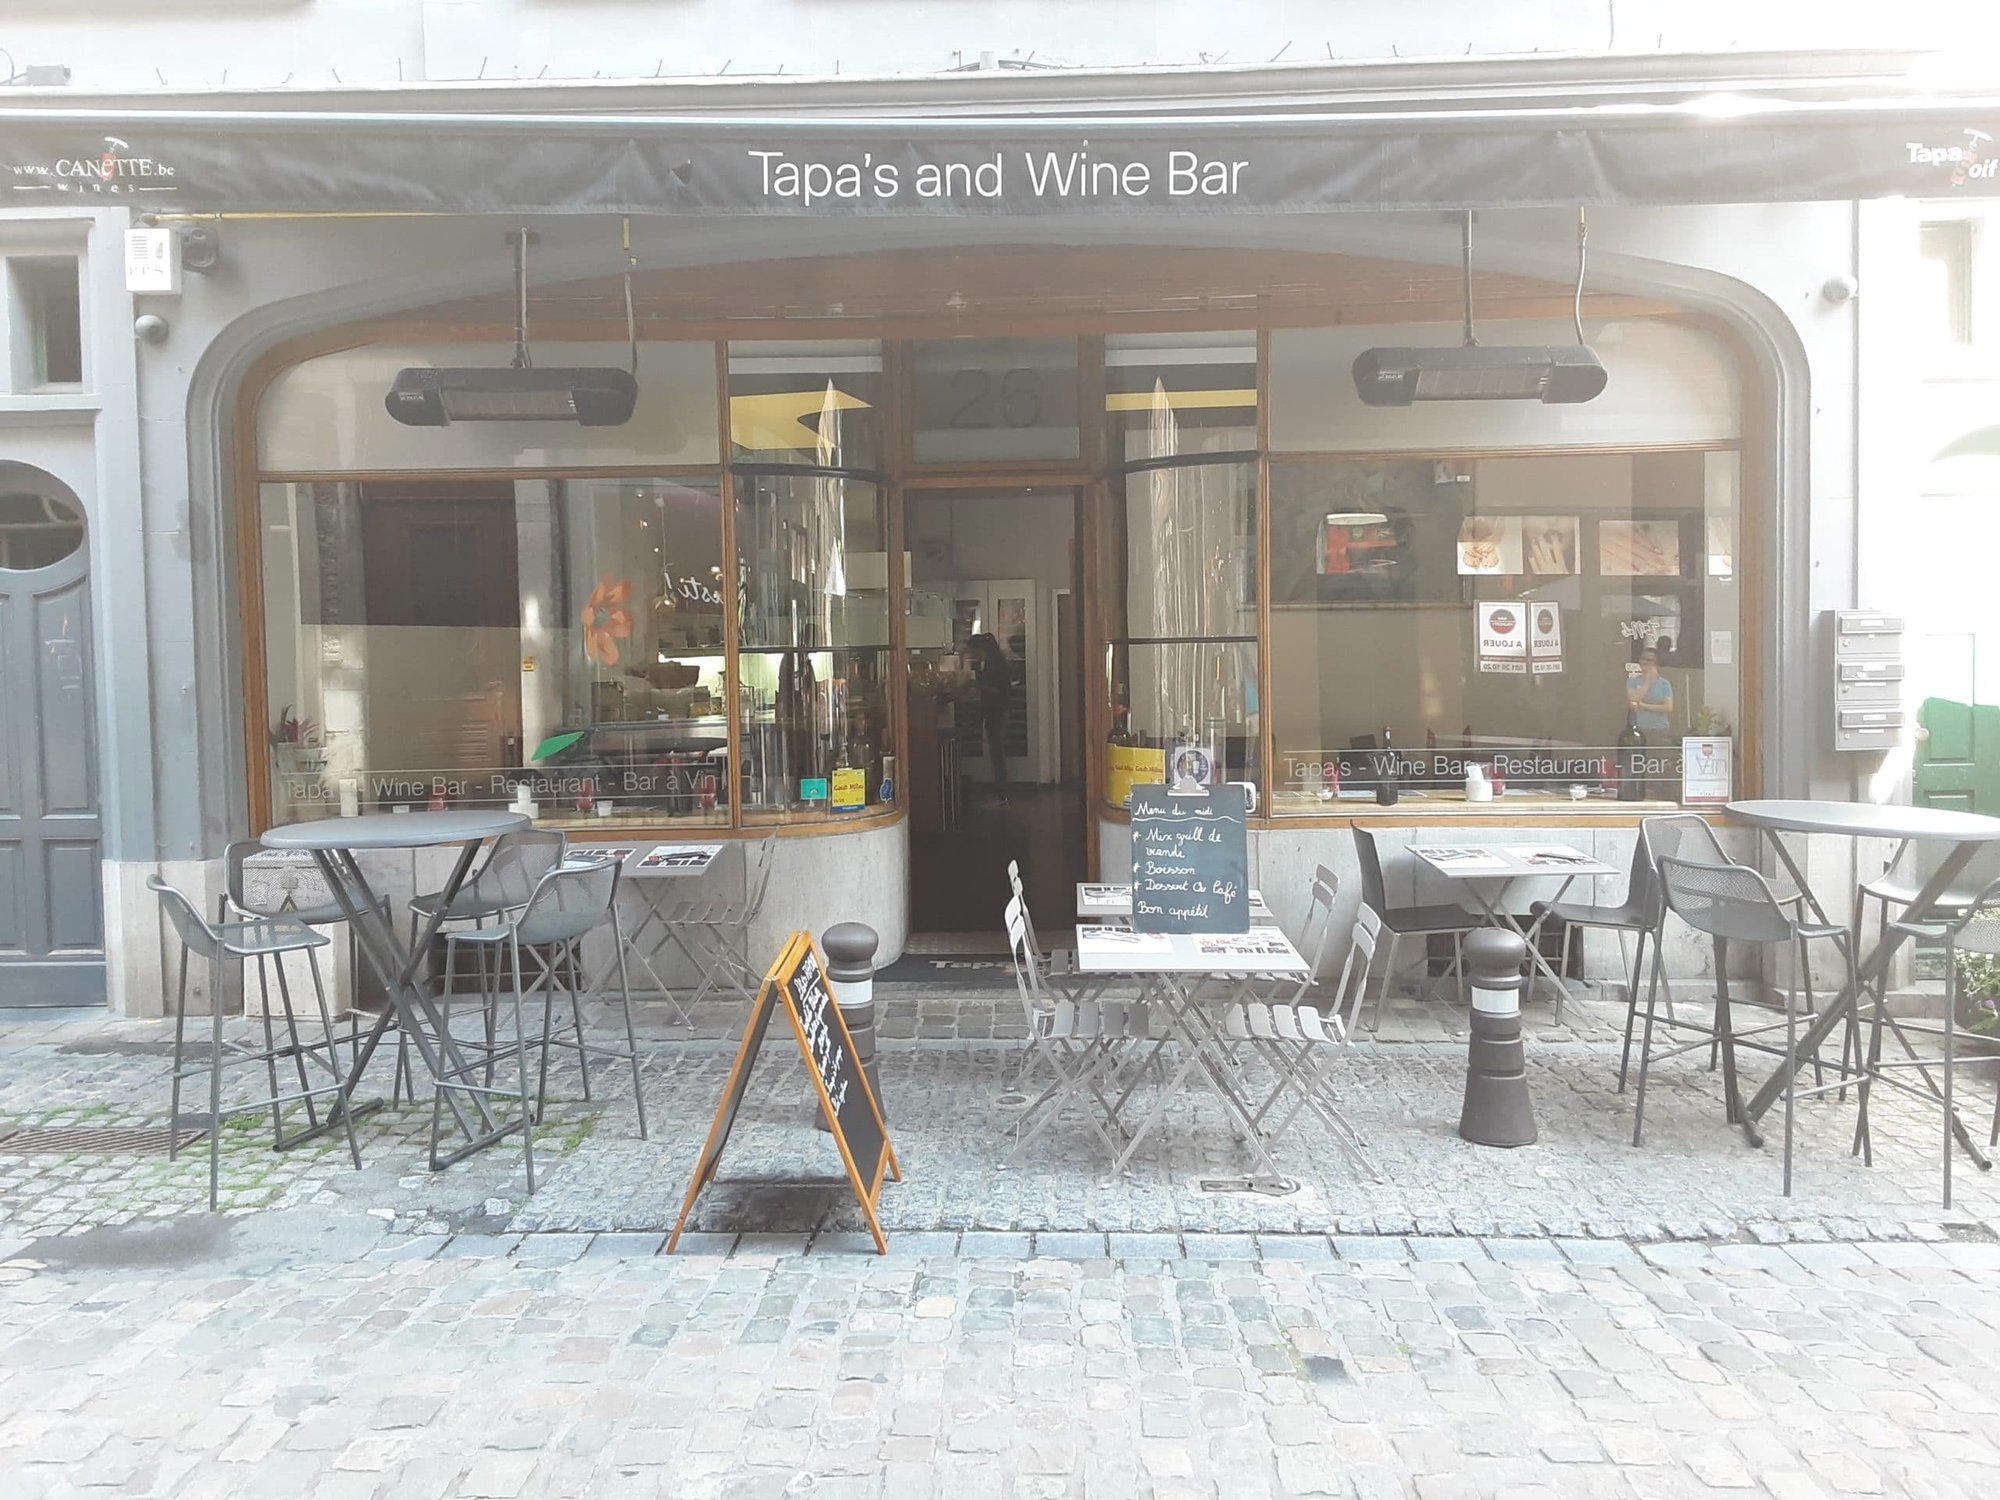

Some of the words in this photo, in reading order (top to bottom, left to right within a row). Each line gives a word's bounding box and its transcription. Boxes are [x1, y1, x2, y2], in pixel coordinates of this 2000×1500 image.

[748, 149, 900, 207] Tapa's
[914, 152, 1003, 198] and
[1023, 139, 1151, 197] Wine
[1167, 150, 1249, 197] Bar
[949, 367, 1042, 428] 26
[1284, 756, 1352, 778] Tapa's
[1373, 755, 1426, 776] Wine
[1434, 755, 1474, 776] Bar
[1493, 754, 1608, 775] Restaurant
[1630, 754, 1669, 775] Bar
[372, 777, 424, 797] Wine
[432, 776, 468, 796] Bar
[489, 774, 601, 795] Restaurant
[623, 771, 660, 791] Bar
[666, 770, 679, 790] à
[683, 770, 717, 790] Vin
[1134, 800, 1167, 816] Menu
[1171, 805, 1187, 816] du
[1145, 828, 1173, 842] Mix
[1175, 826, 1204, 847] grill
[1208, 828, 1223, 843] de
[1145, 845, 1186, 859] viande
[1144, 861, 1196, 875] Boisson
[1144, 878, 1190, 892] Dessert
[1212, 879, 1239, 905] Café
[1136, 900, 1164, 915] Bon
[1168, 903, 1210, 922] appétit
